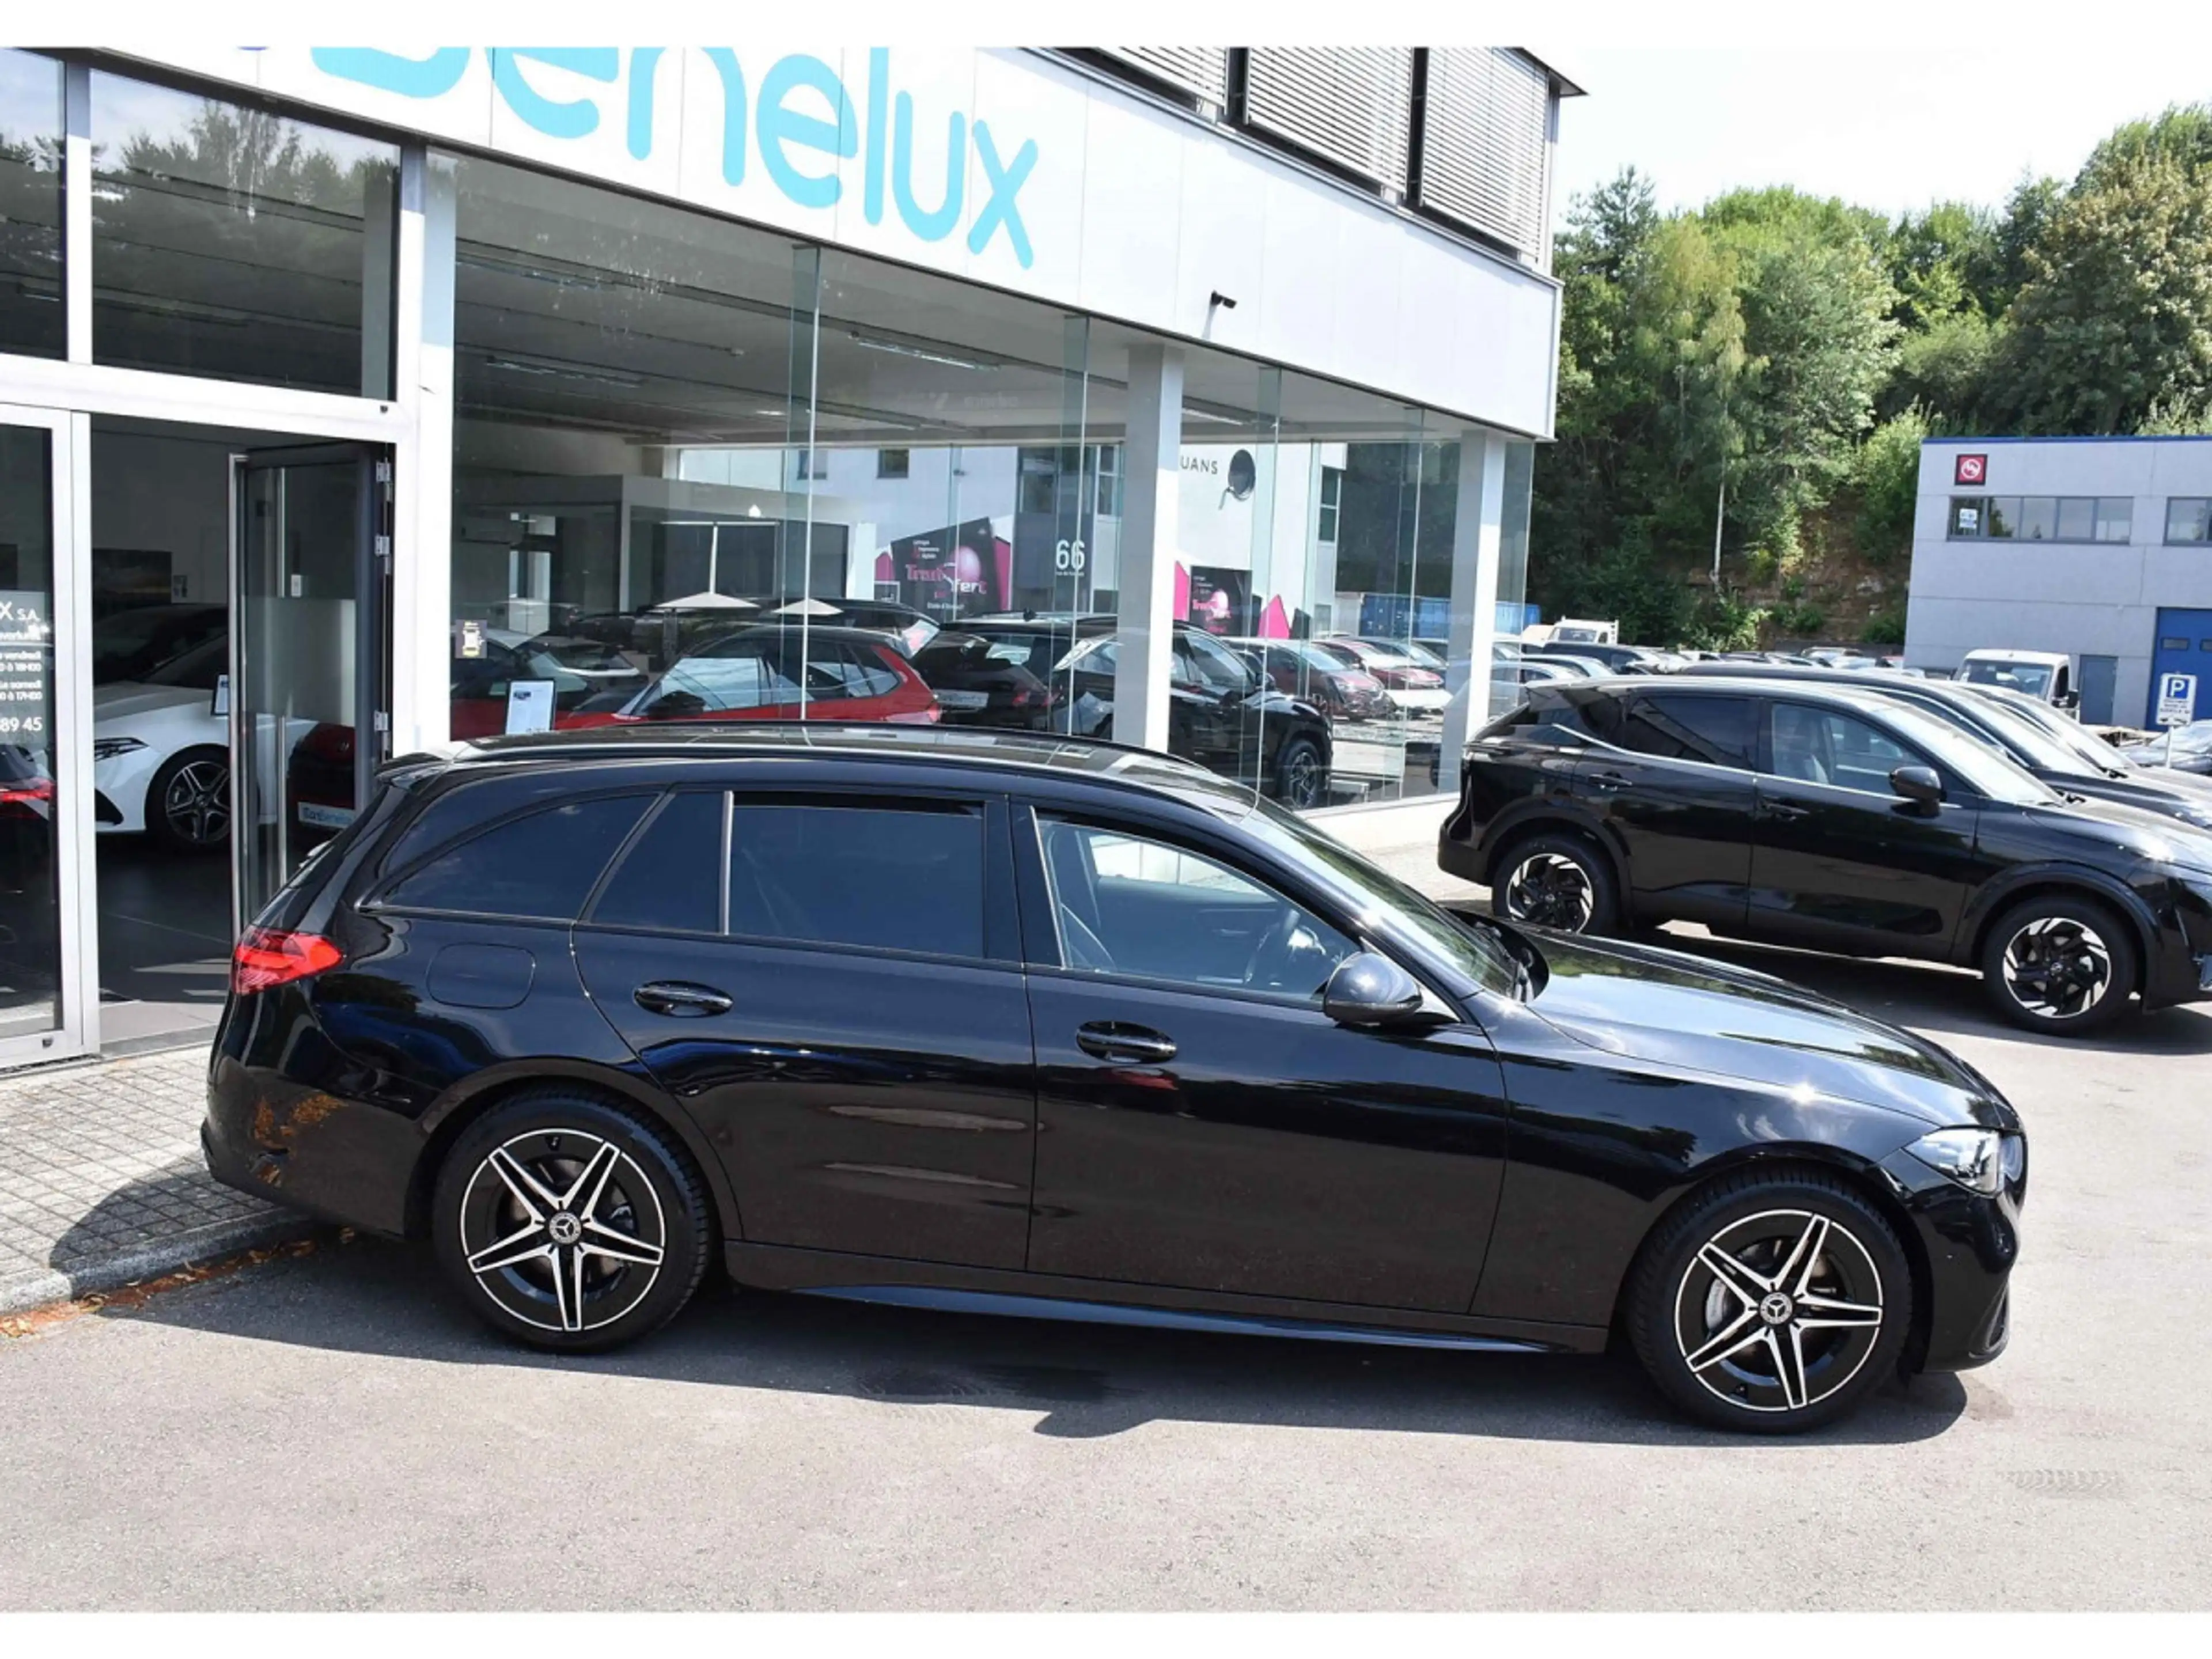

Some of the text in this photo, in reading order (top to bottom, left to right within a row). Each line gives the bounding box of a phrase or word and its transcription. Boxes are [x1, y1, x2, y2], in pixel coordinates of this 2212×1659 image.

[1056, 539, 1085, 570] 66
[2170, 679, 2186, 697] P
[0, 717, 43, 732] 89 45
